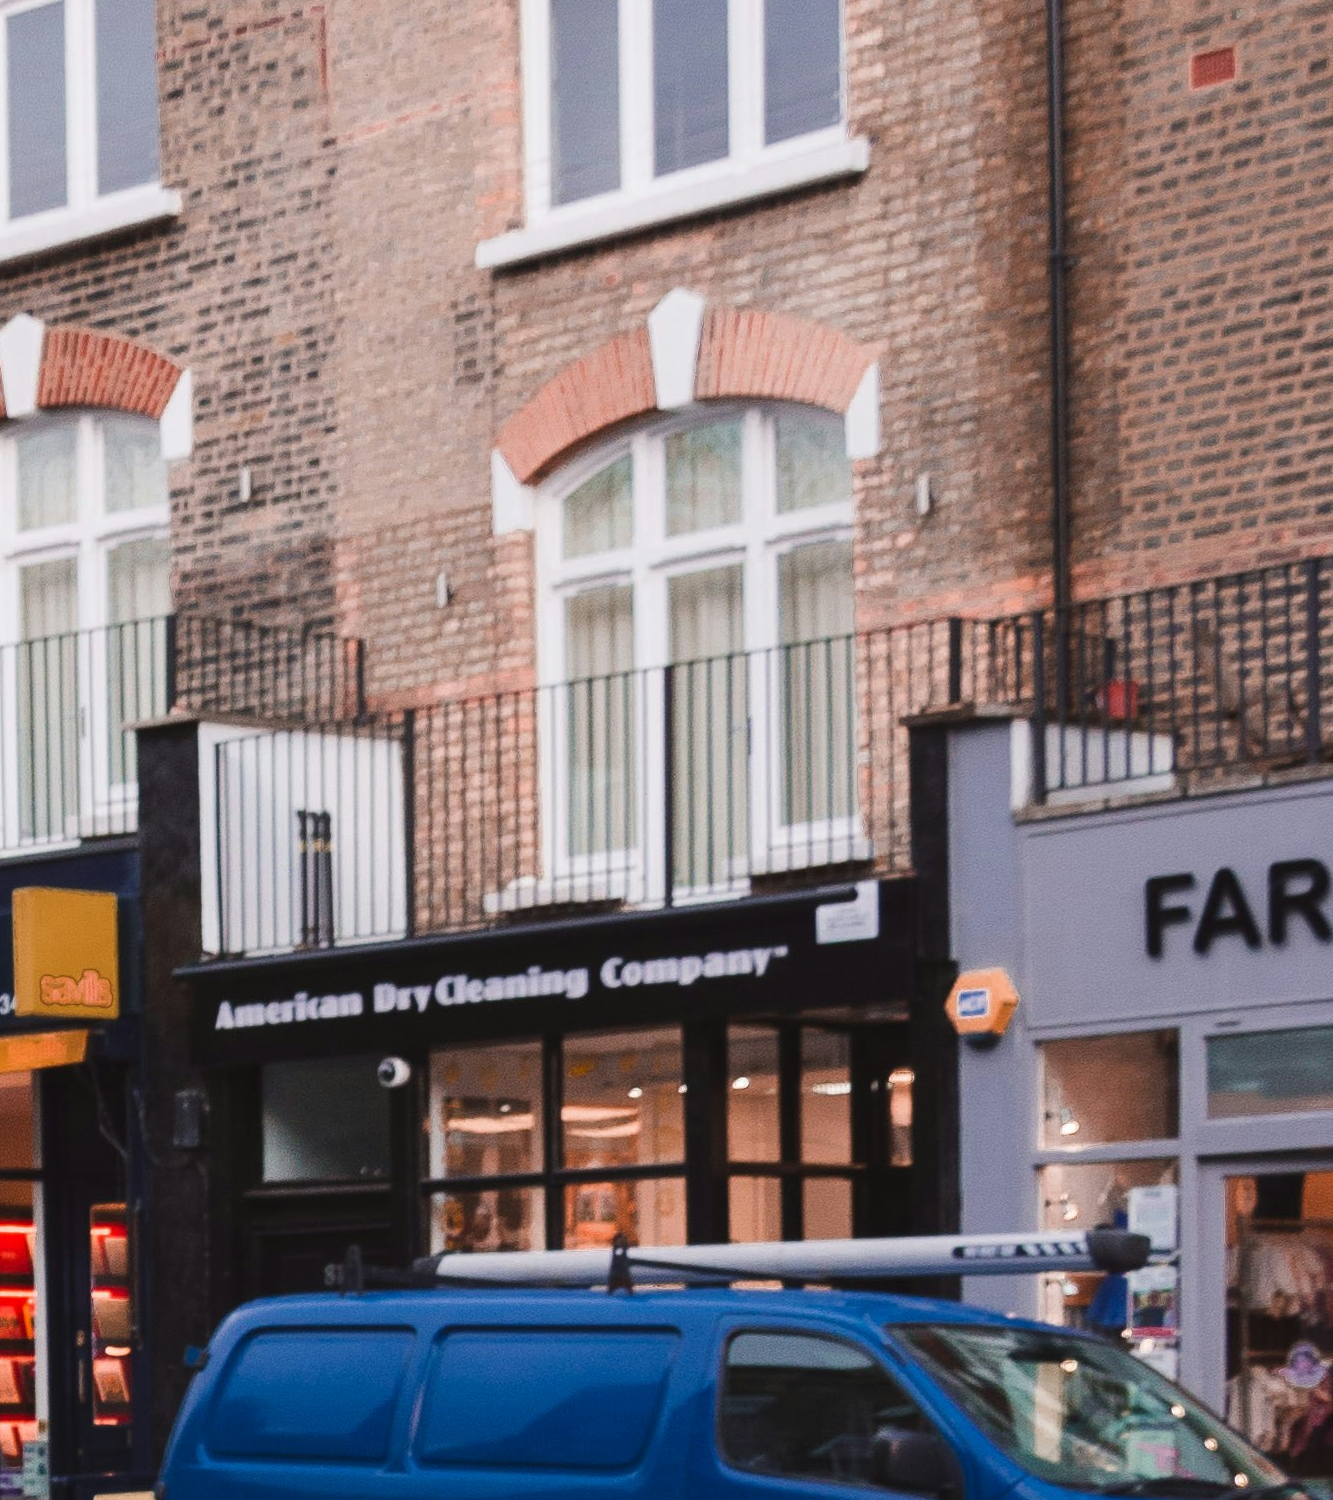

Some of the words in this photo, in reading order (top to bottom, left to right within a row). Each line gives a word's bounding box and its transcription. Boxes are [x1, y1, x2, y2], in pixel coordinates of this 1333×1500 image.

[1144, 857, 1333, 962] FAR
[214, 991, 364, 1031] American
[372, 982, 432, 1014] Dry
[434, 964, 590, 1007] Cleaning
